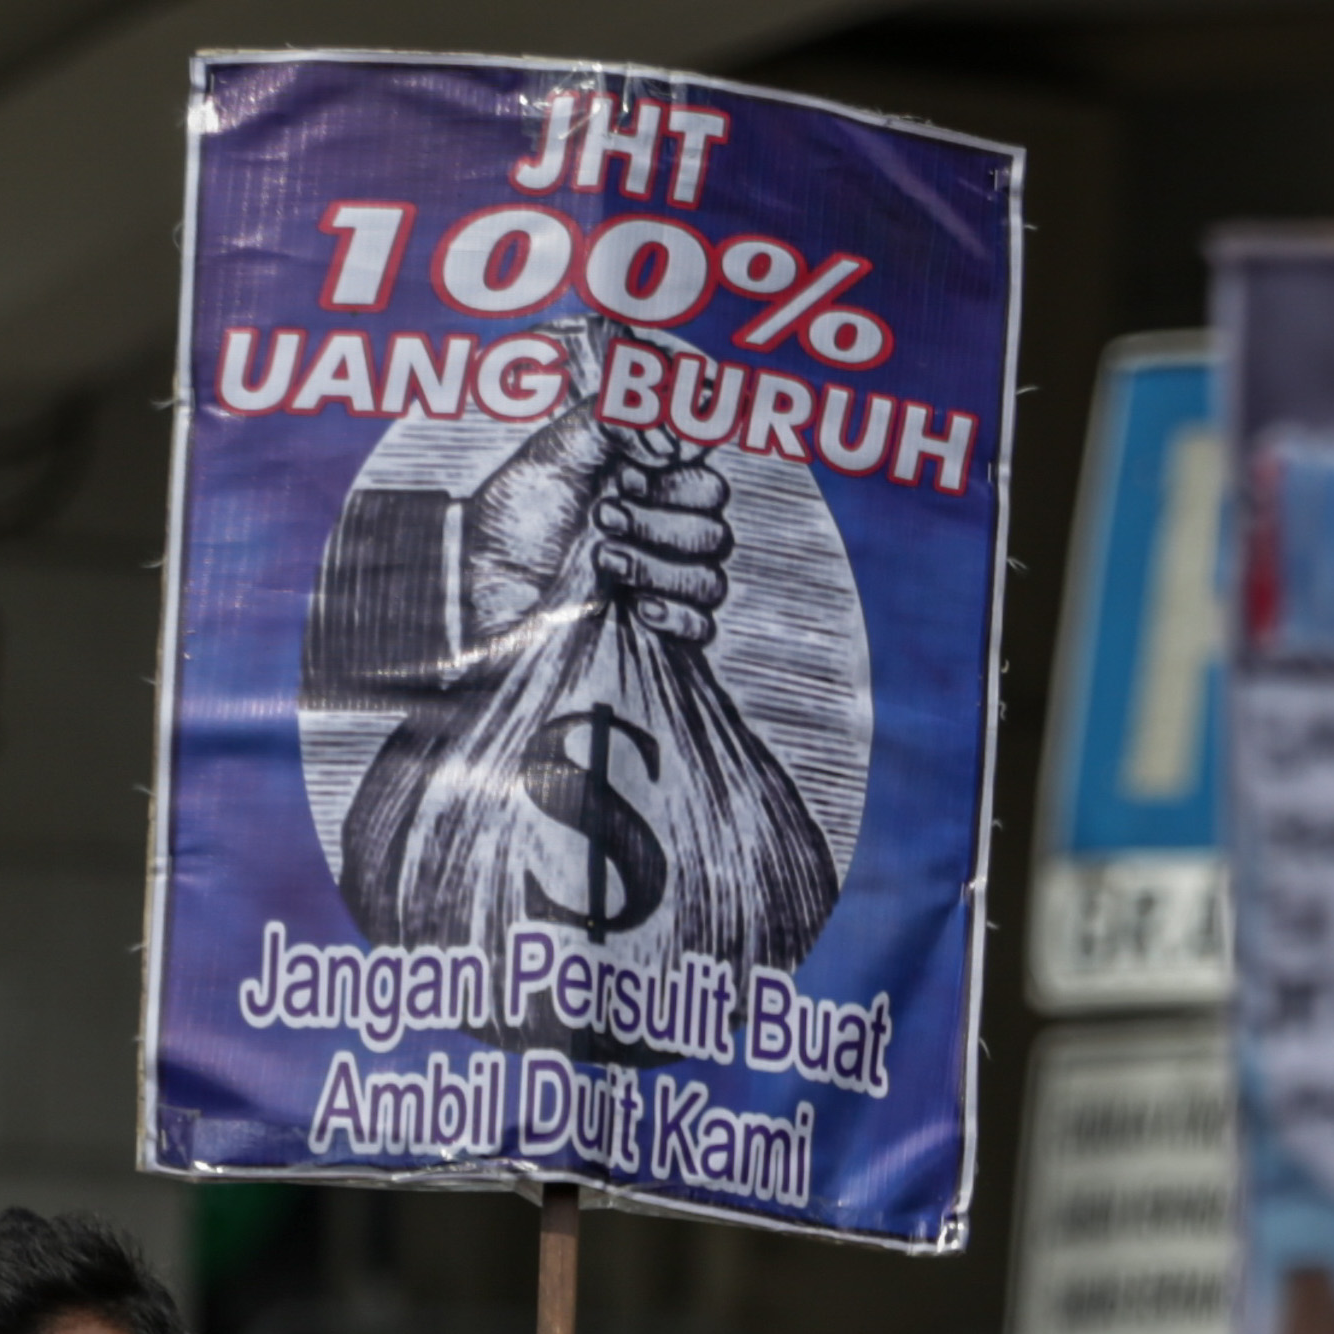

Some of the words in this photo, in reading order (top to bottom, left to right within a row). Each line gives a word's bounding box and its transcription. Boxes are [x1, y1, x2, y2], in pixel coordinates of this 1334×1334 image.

[510, 91, 730, 208] JHT
[320, 201, 894, 370] 100%
[217, 328, 568, 420] UANG
[596, 338, 978, 496] BURUH
[241, 920, 488, 1052] Jangan
[505, 920, 737, 1064] Persulit
[745, 966, 891, 1098] Buat
[309, 1052, 504, 1155] Ambil
[518, 1049, 642, 1174] Duit
[650, 1079, 815, 1207] Kami
